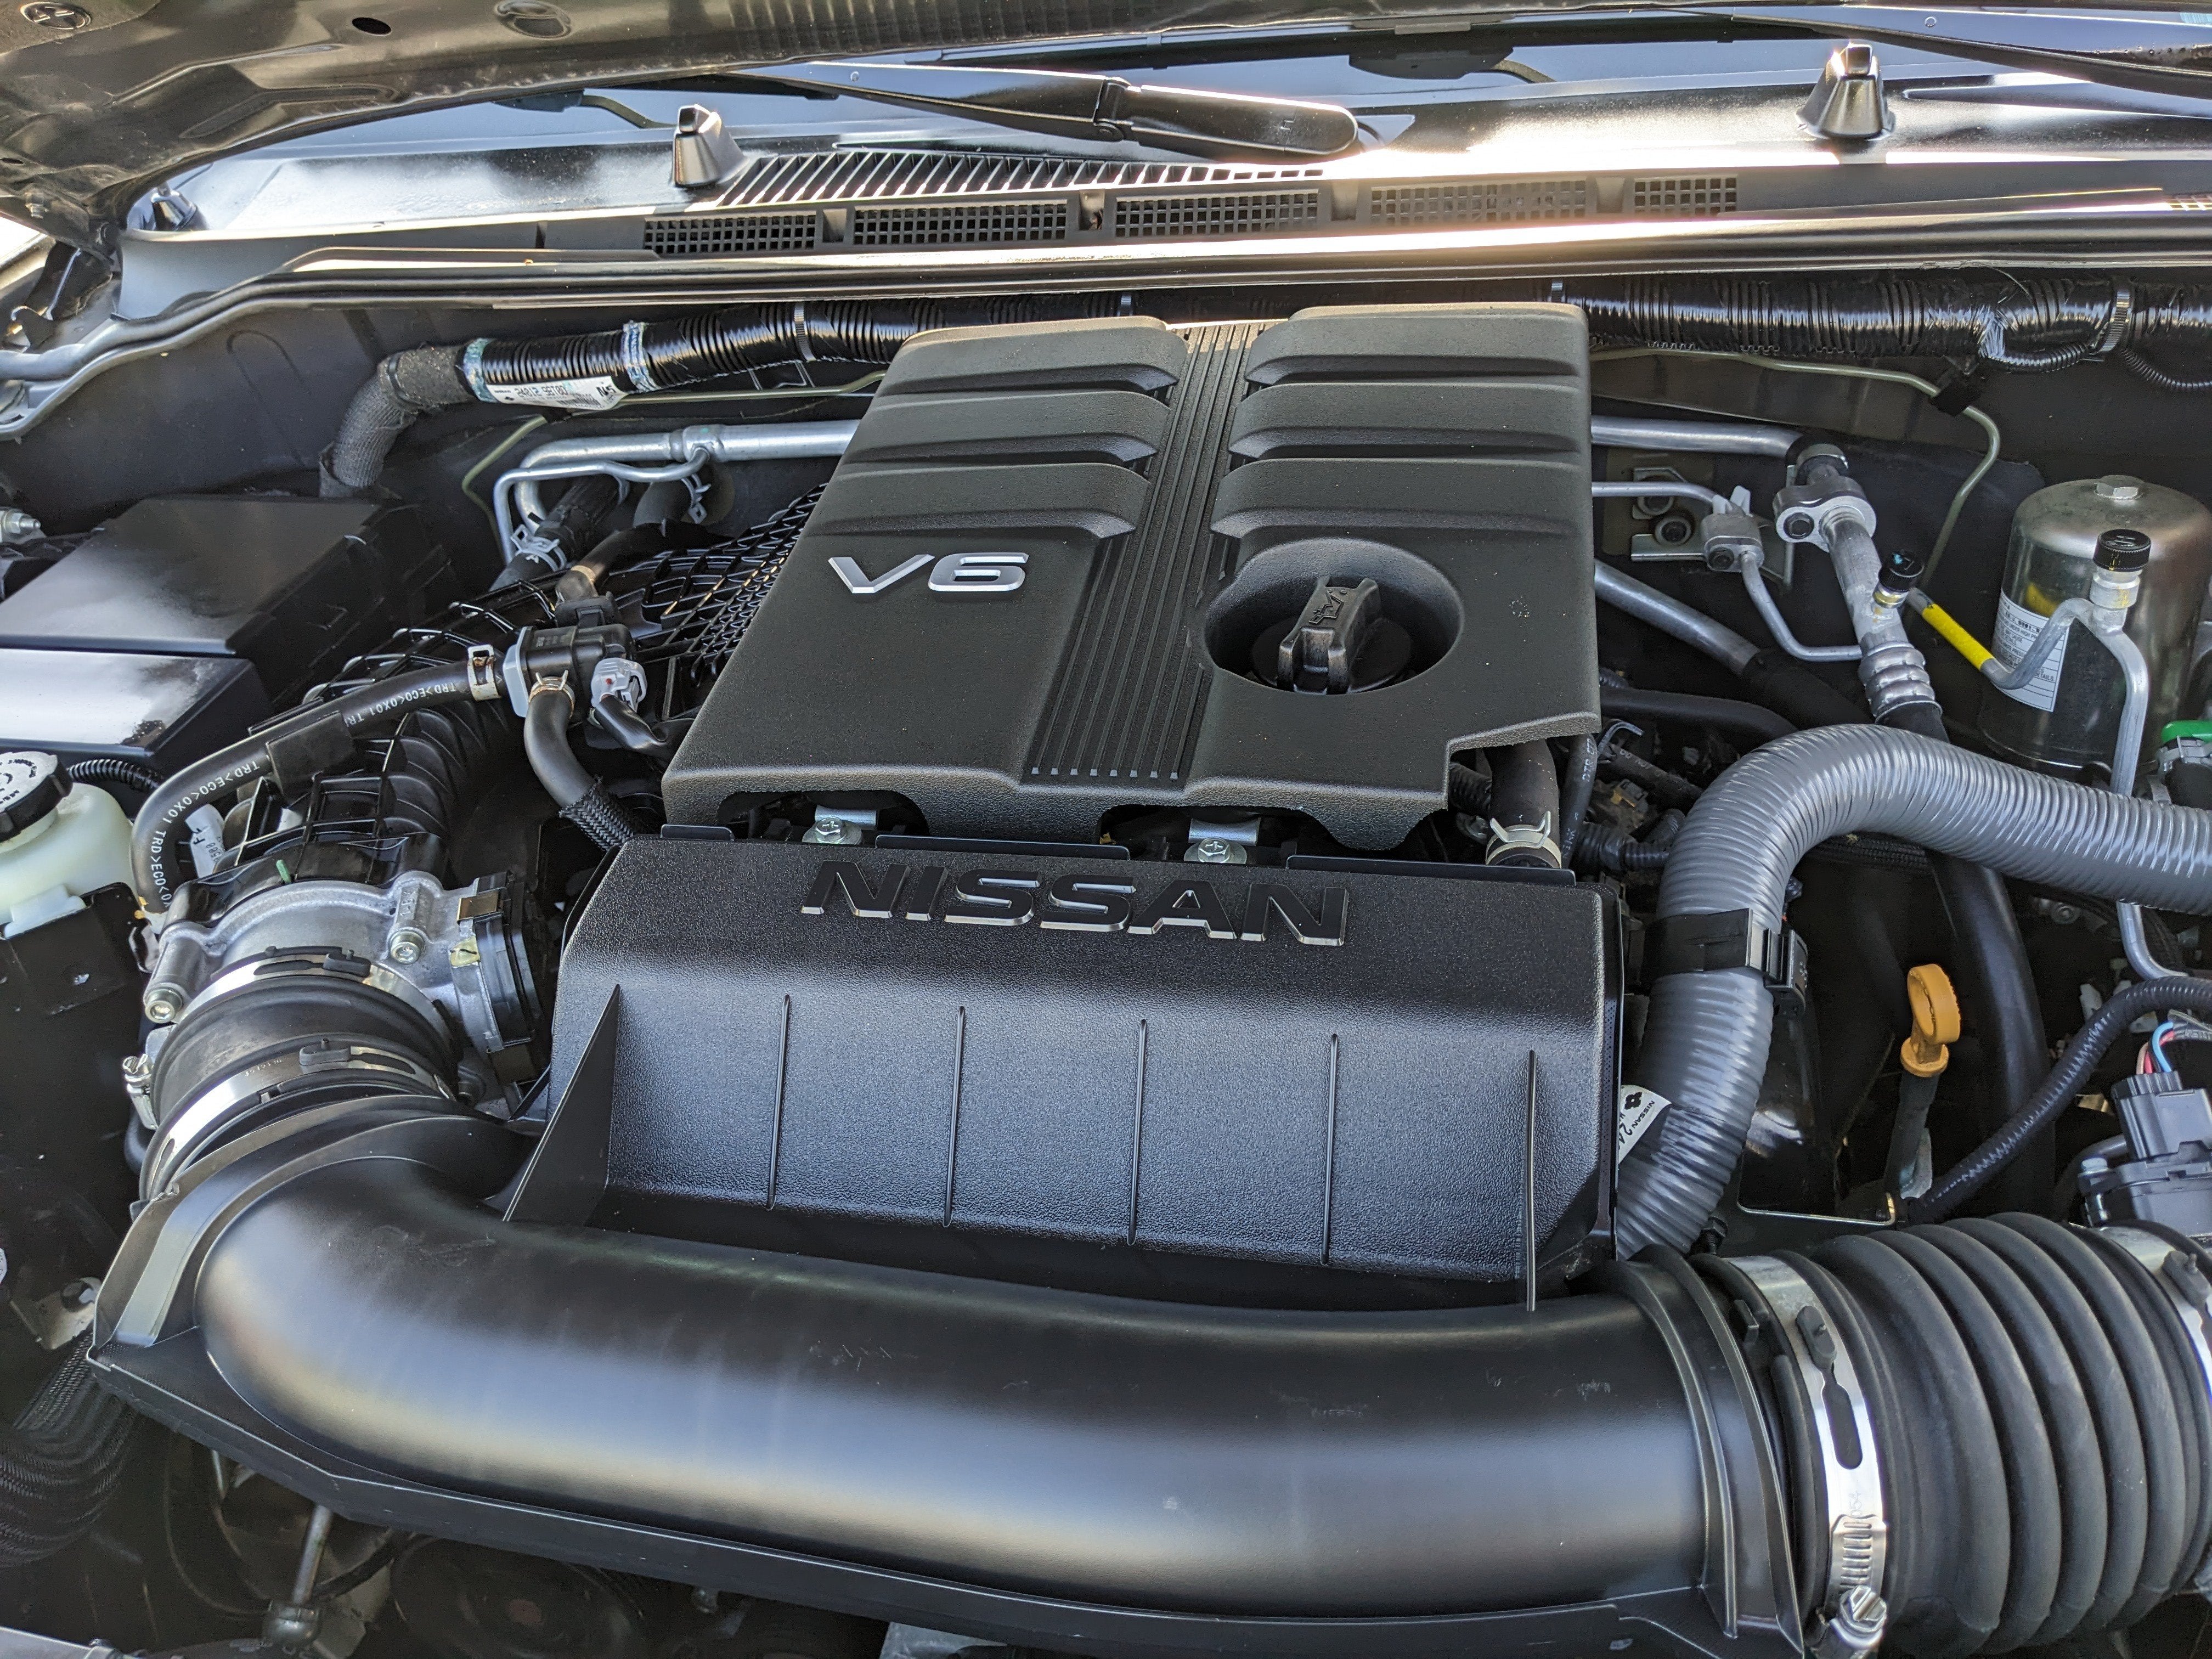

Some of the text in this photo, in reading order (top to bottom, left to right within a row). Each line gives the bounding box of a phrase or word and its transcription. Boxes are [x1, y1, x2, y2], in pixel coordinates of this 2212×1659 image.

[828, 552, 1029, 594] V6
[800, 860, 1348, 946] NISSAN
[1631, 1100, 1655, 1129] NISSAN
